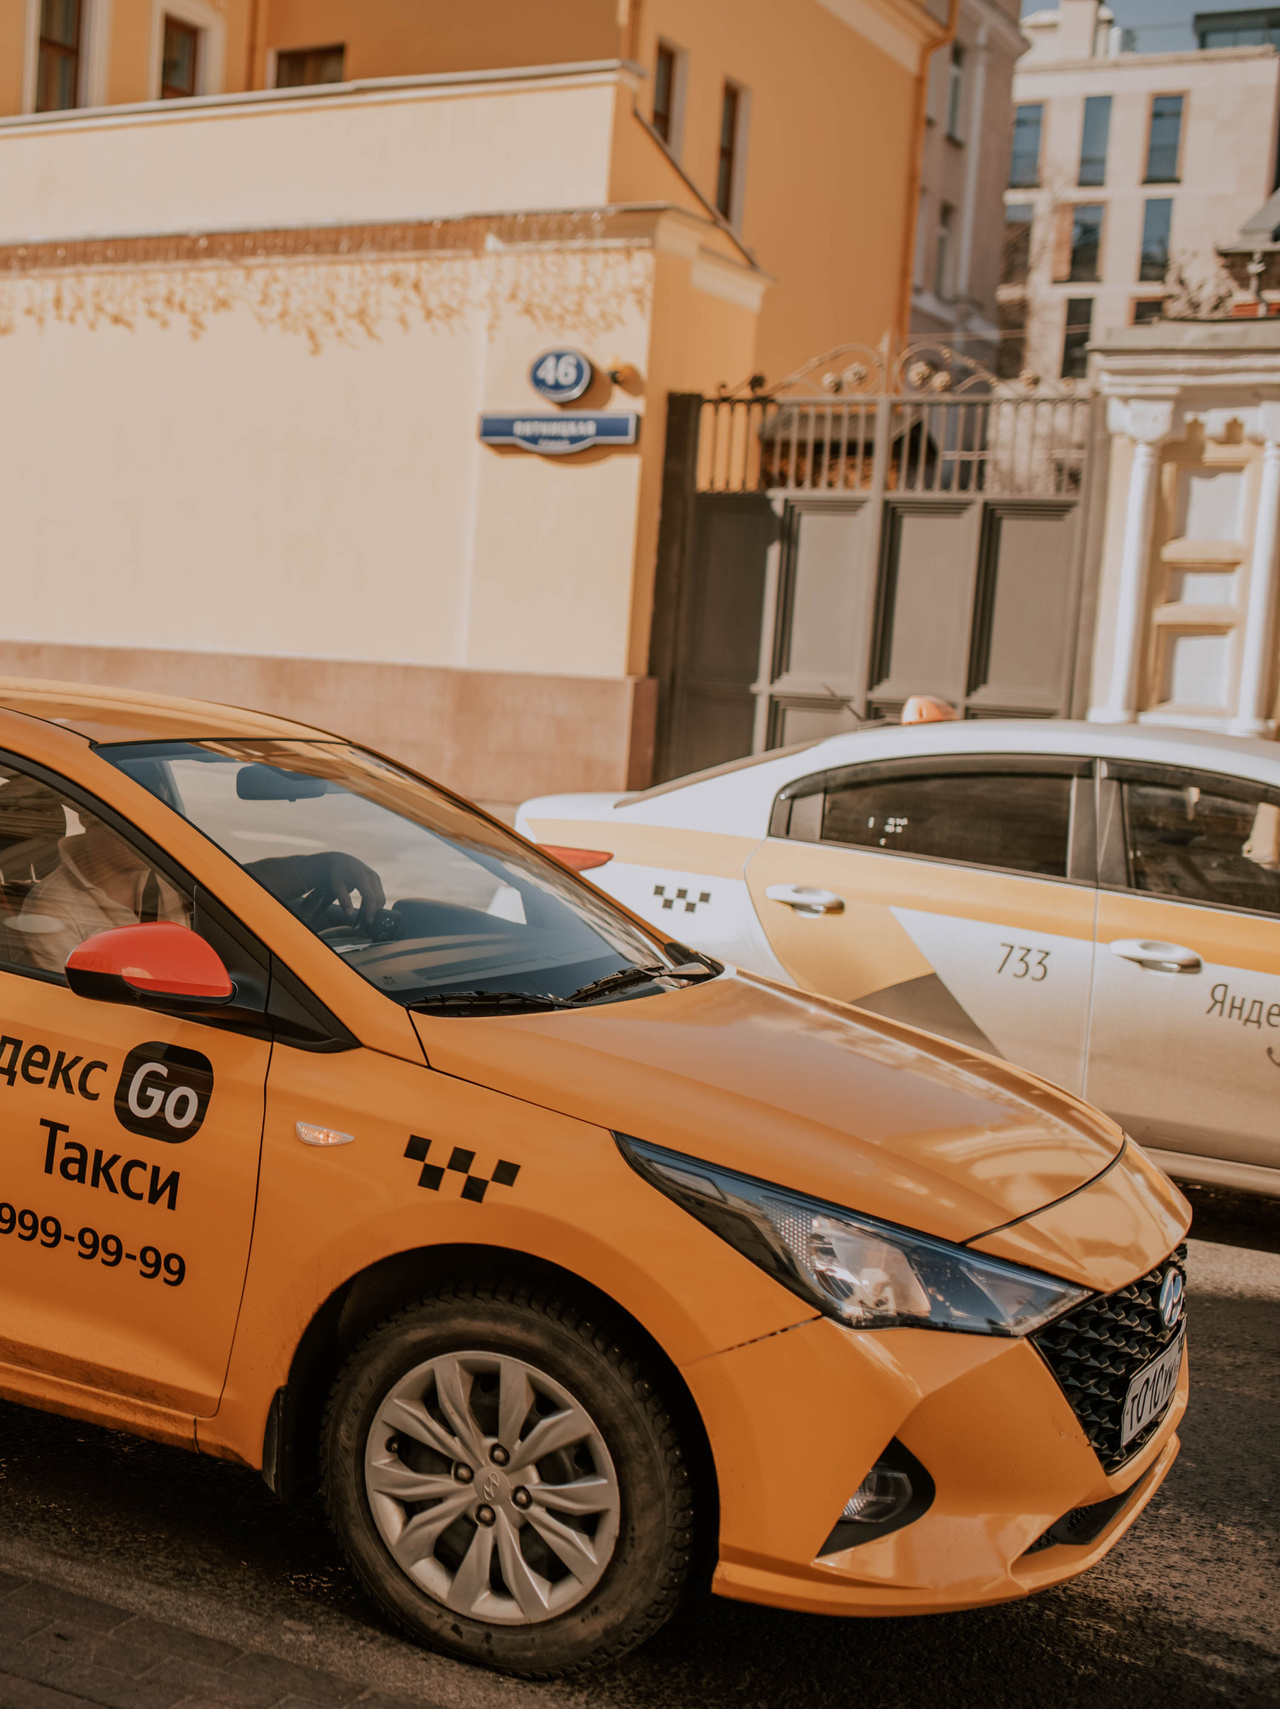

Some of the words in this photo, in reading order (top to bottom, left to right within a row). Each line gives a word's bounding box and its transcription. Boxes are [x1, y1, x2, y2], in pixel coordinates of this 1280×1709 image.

[536, 354, 578, 386] 46
[996, 942, 1051, 982] 733
[128, 1062, 198, 1129] Go
[38, 1118, 180, 1211] Такси
